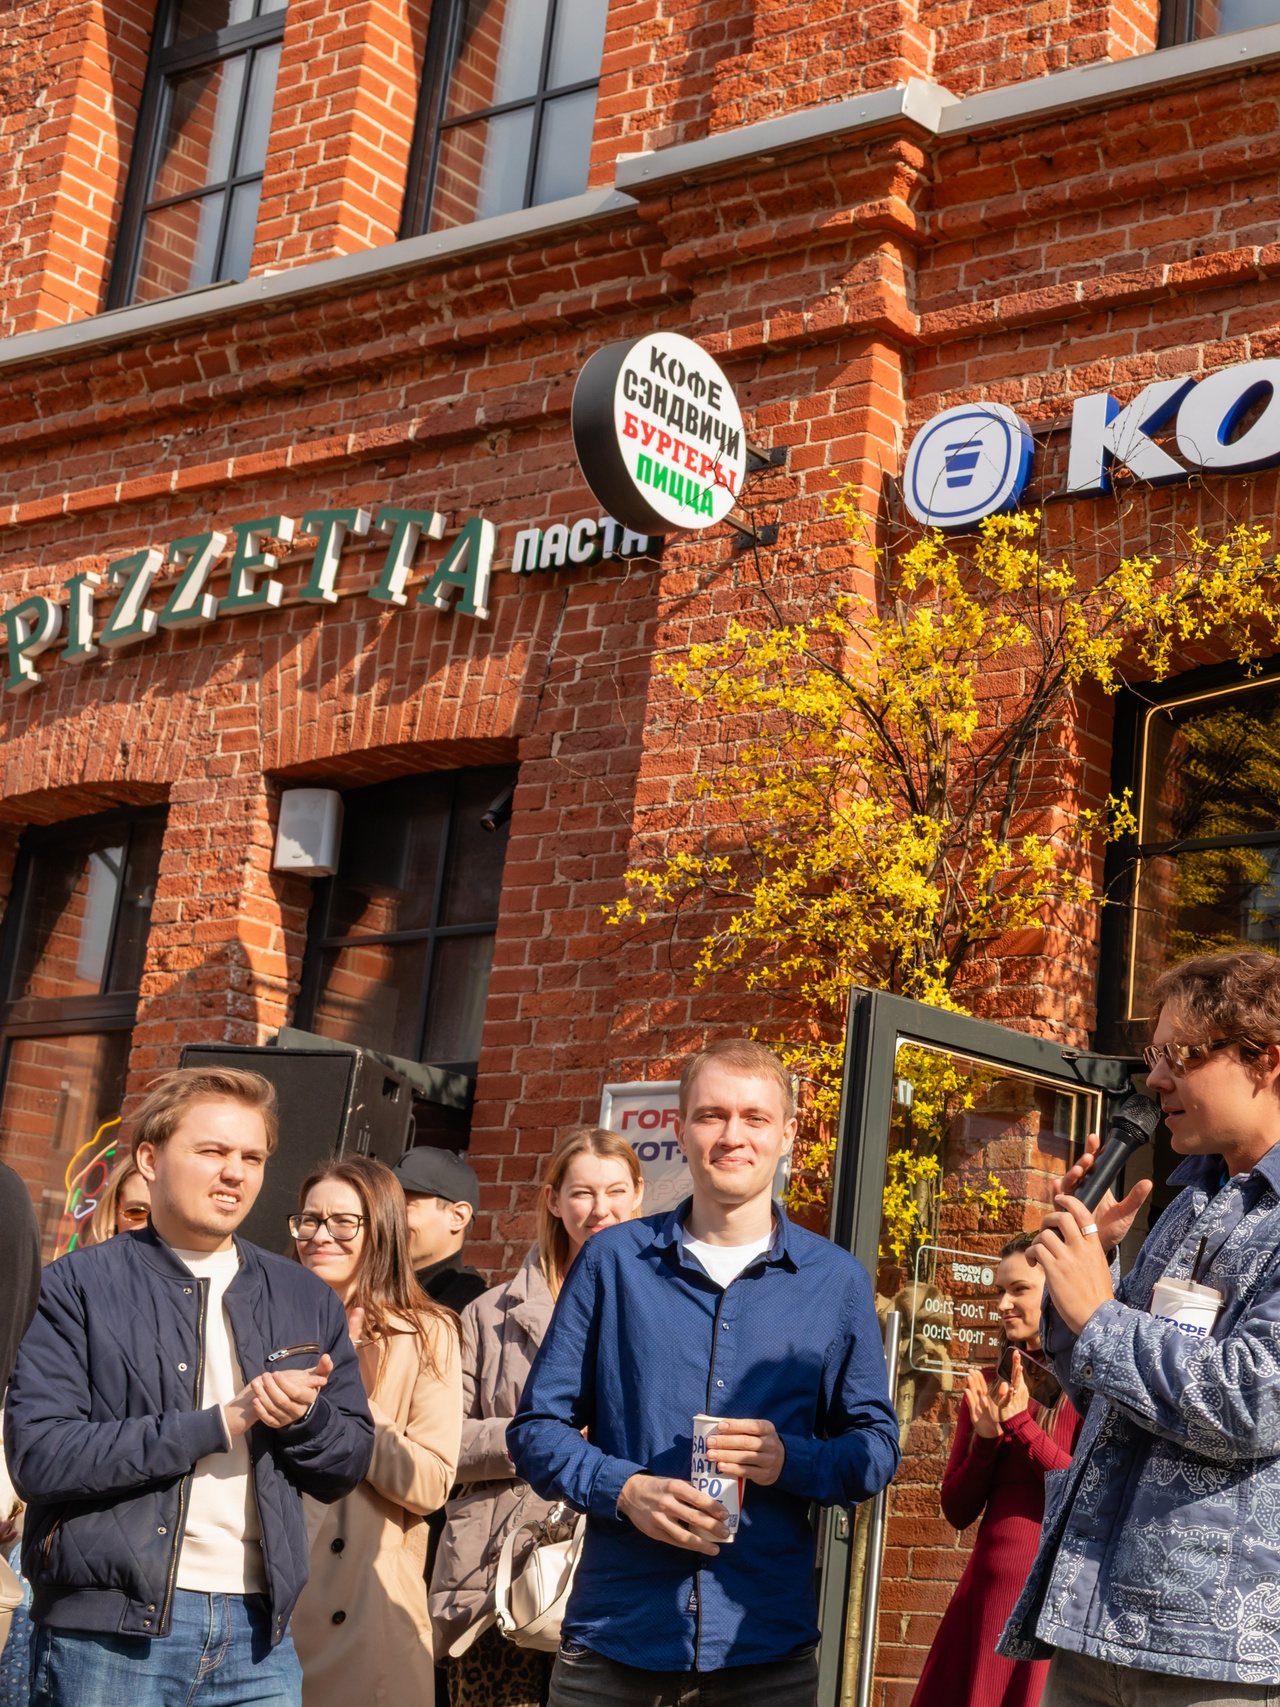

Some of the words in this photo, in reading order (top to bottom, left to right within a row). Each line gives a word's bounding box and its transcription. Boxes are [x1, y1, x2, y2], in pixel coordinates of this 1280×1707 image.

[623, 368, 740, 460] СЭНДВИЧИ
[650, 345, 722, 411] КОФЕ
[622, 411, 737, 495] БУРГЕРЫ
[636, 453, 714, 518] ПИЦЦА
[0, 506, 496, 694] PIZZETTA
[621, 1108, 681, 1131] ГОР
